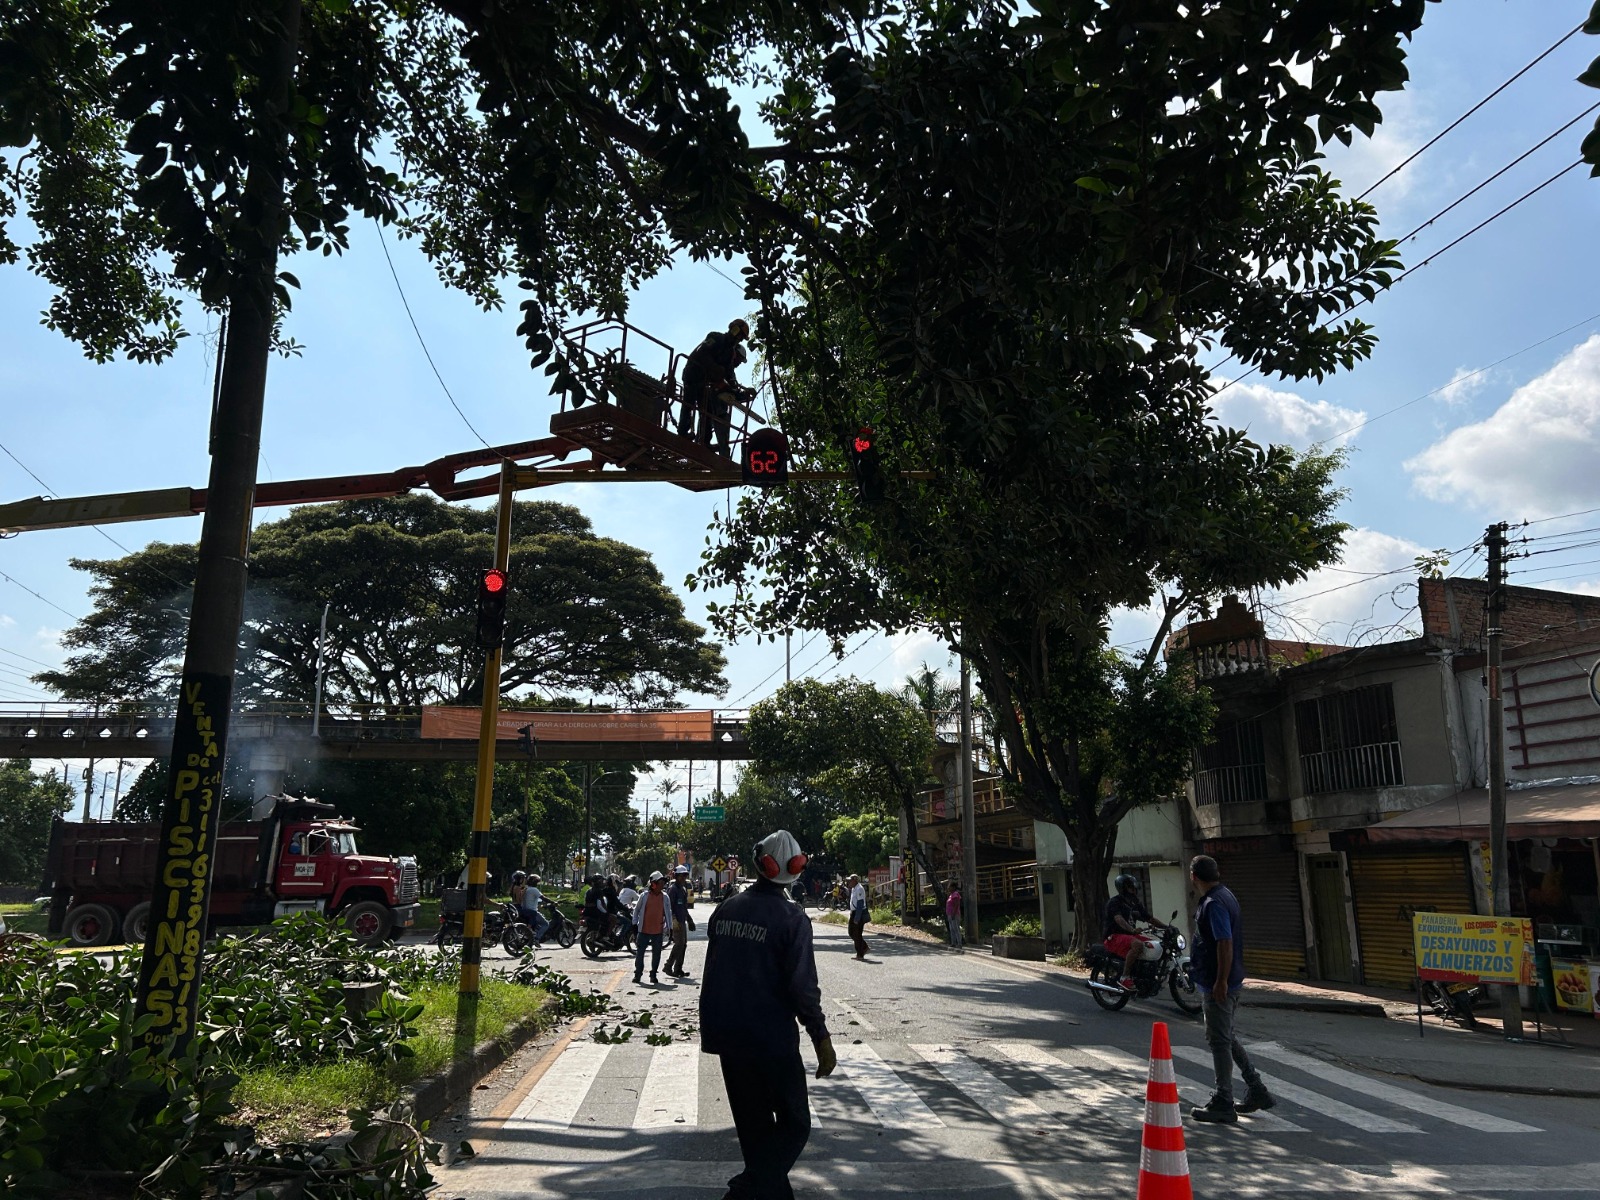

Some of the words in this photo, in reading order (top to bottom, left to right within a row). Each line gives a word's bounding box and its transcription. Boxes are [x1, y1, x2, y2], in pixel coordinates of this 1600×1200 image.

[750, 450, 779, 474] 62
[185, 681, 219, 758] VENTA
[146, 769, 200, 1027] PISCINAS
[1417, 923, 1463, 935] EXQUISIPAN
[1465, 922, 1475, 930] LOS
[1475, 921, 1498, 929] COMBOS
[1420, 935, 1497, 953] DESAYUNOS
[1503, 940, 1512, 954] Y
[1421, 951, 1514, 973] ALMUERZOS
